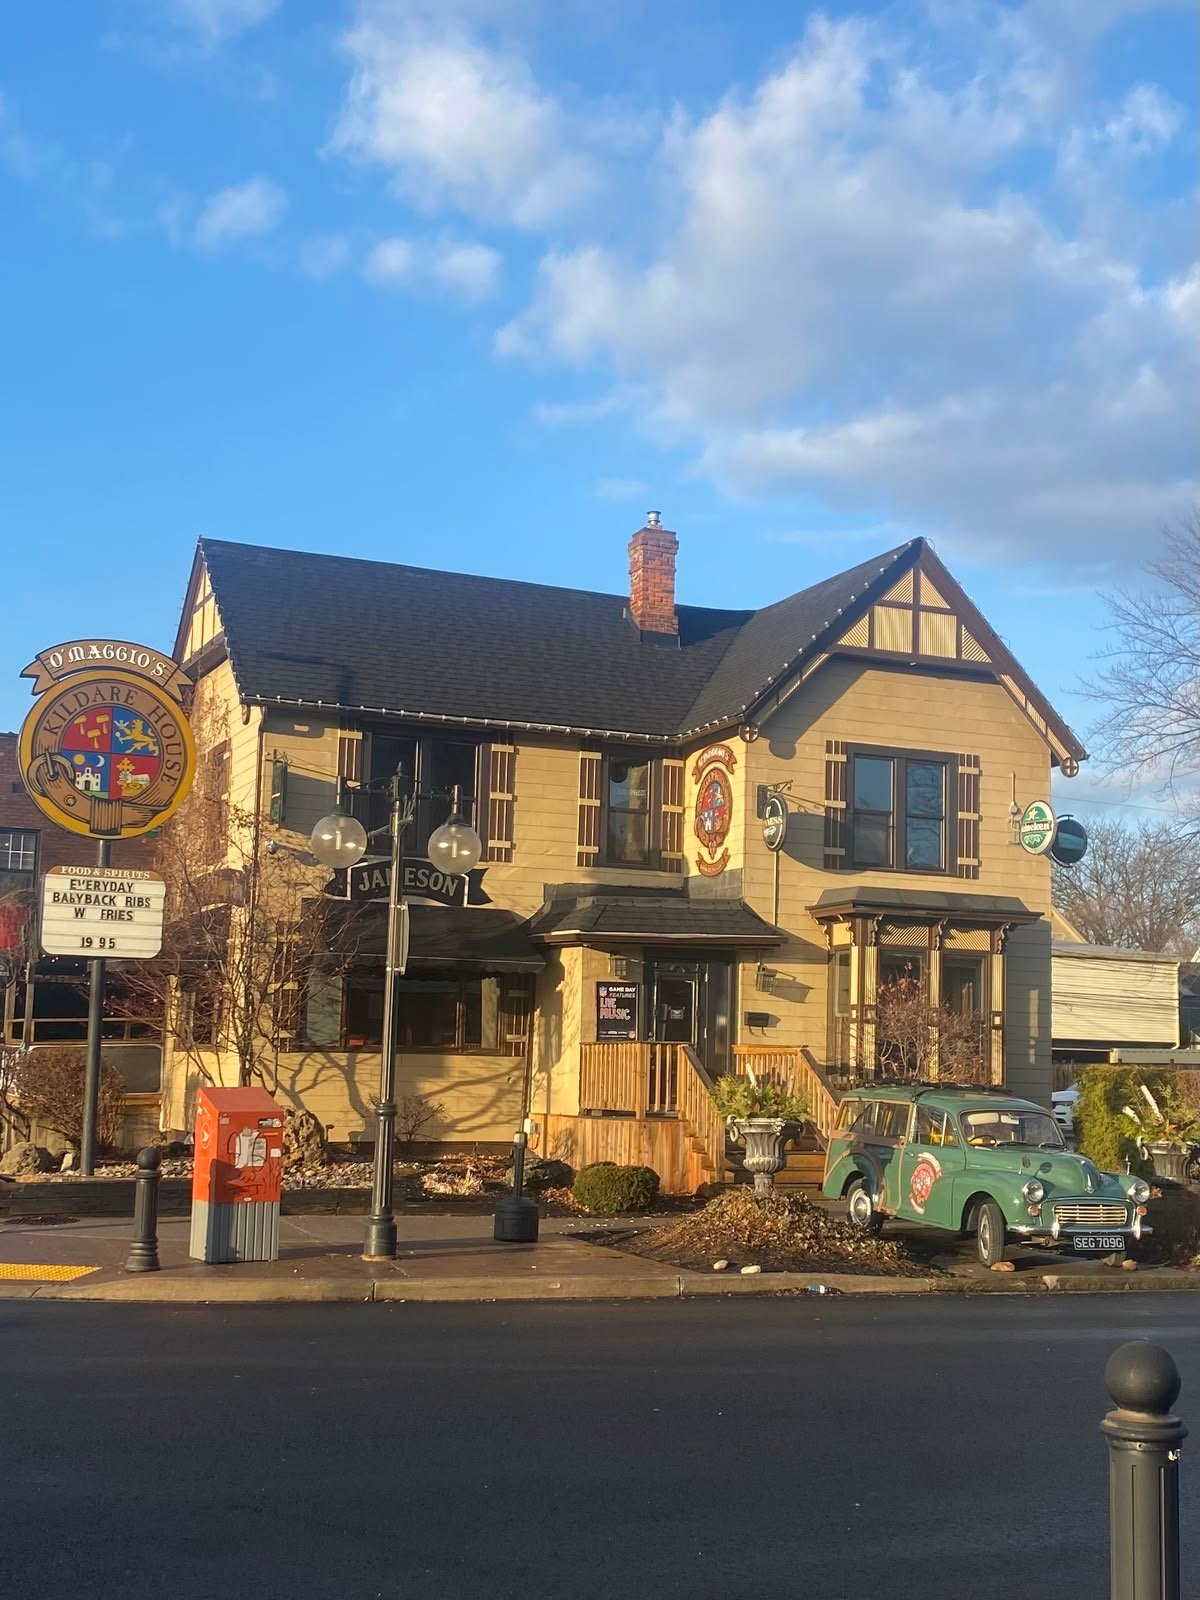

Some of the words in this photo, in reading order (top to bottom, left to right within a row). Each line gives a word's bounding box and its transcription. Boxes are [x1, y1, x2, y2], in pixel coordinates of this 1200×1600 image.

[49, 645, 167, 676] O'MAGGIO'S
[43, 685, 138, 736] KILDARE
[148, 706, 182, 787] HOUSE
[61, 866, 91, 876] FOOD
[103, 870, 150, 879] SPIRITS
[125, 896, 150, 908] RIBS
[74, 908, 85, 919] W
[100, 909, 133, 920] FRIES
[600, 1008, 631, 1020] MUSIC
[1076, 1238, 1095, 1247] SEG
[1096, 1238, 1122, 1247] 709G
